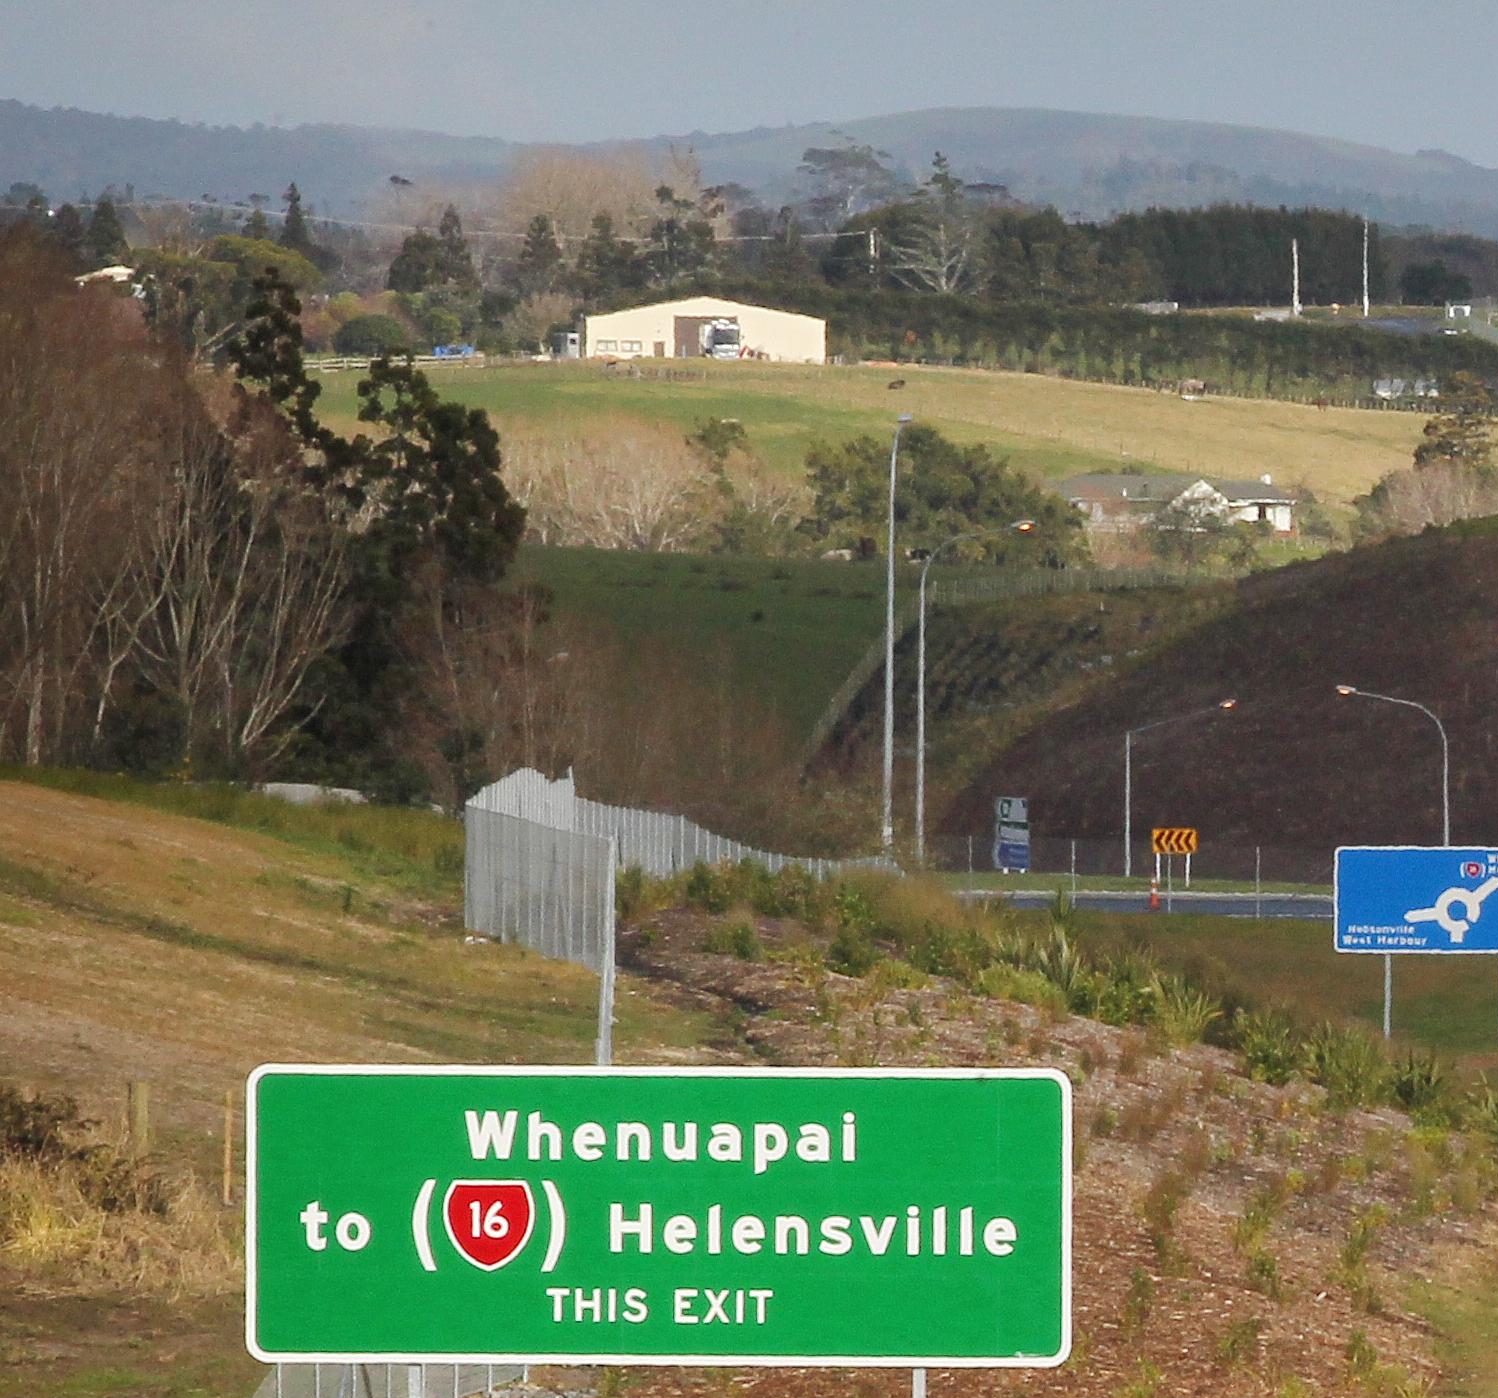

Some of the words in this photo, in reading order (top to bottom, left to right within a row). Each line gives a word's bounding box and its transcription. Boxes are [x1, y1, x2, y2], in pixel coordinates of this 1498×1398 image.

[1341, 934, 1372, 945] West
[1376, 935, 1428, 947] Harbour
[464, 1109, 857, 1175] Whenuapai
[299, 1200, 372, 1252] to
[609, 1202, 1018, 1256] Helensville
[545, 1287, 649, 1323] THIS
[673, 1288, 774, 1324] EXIT
